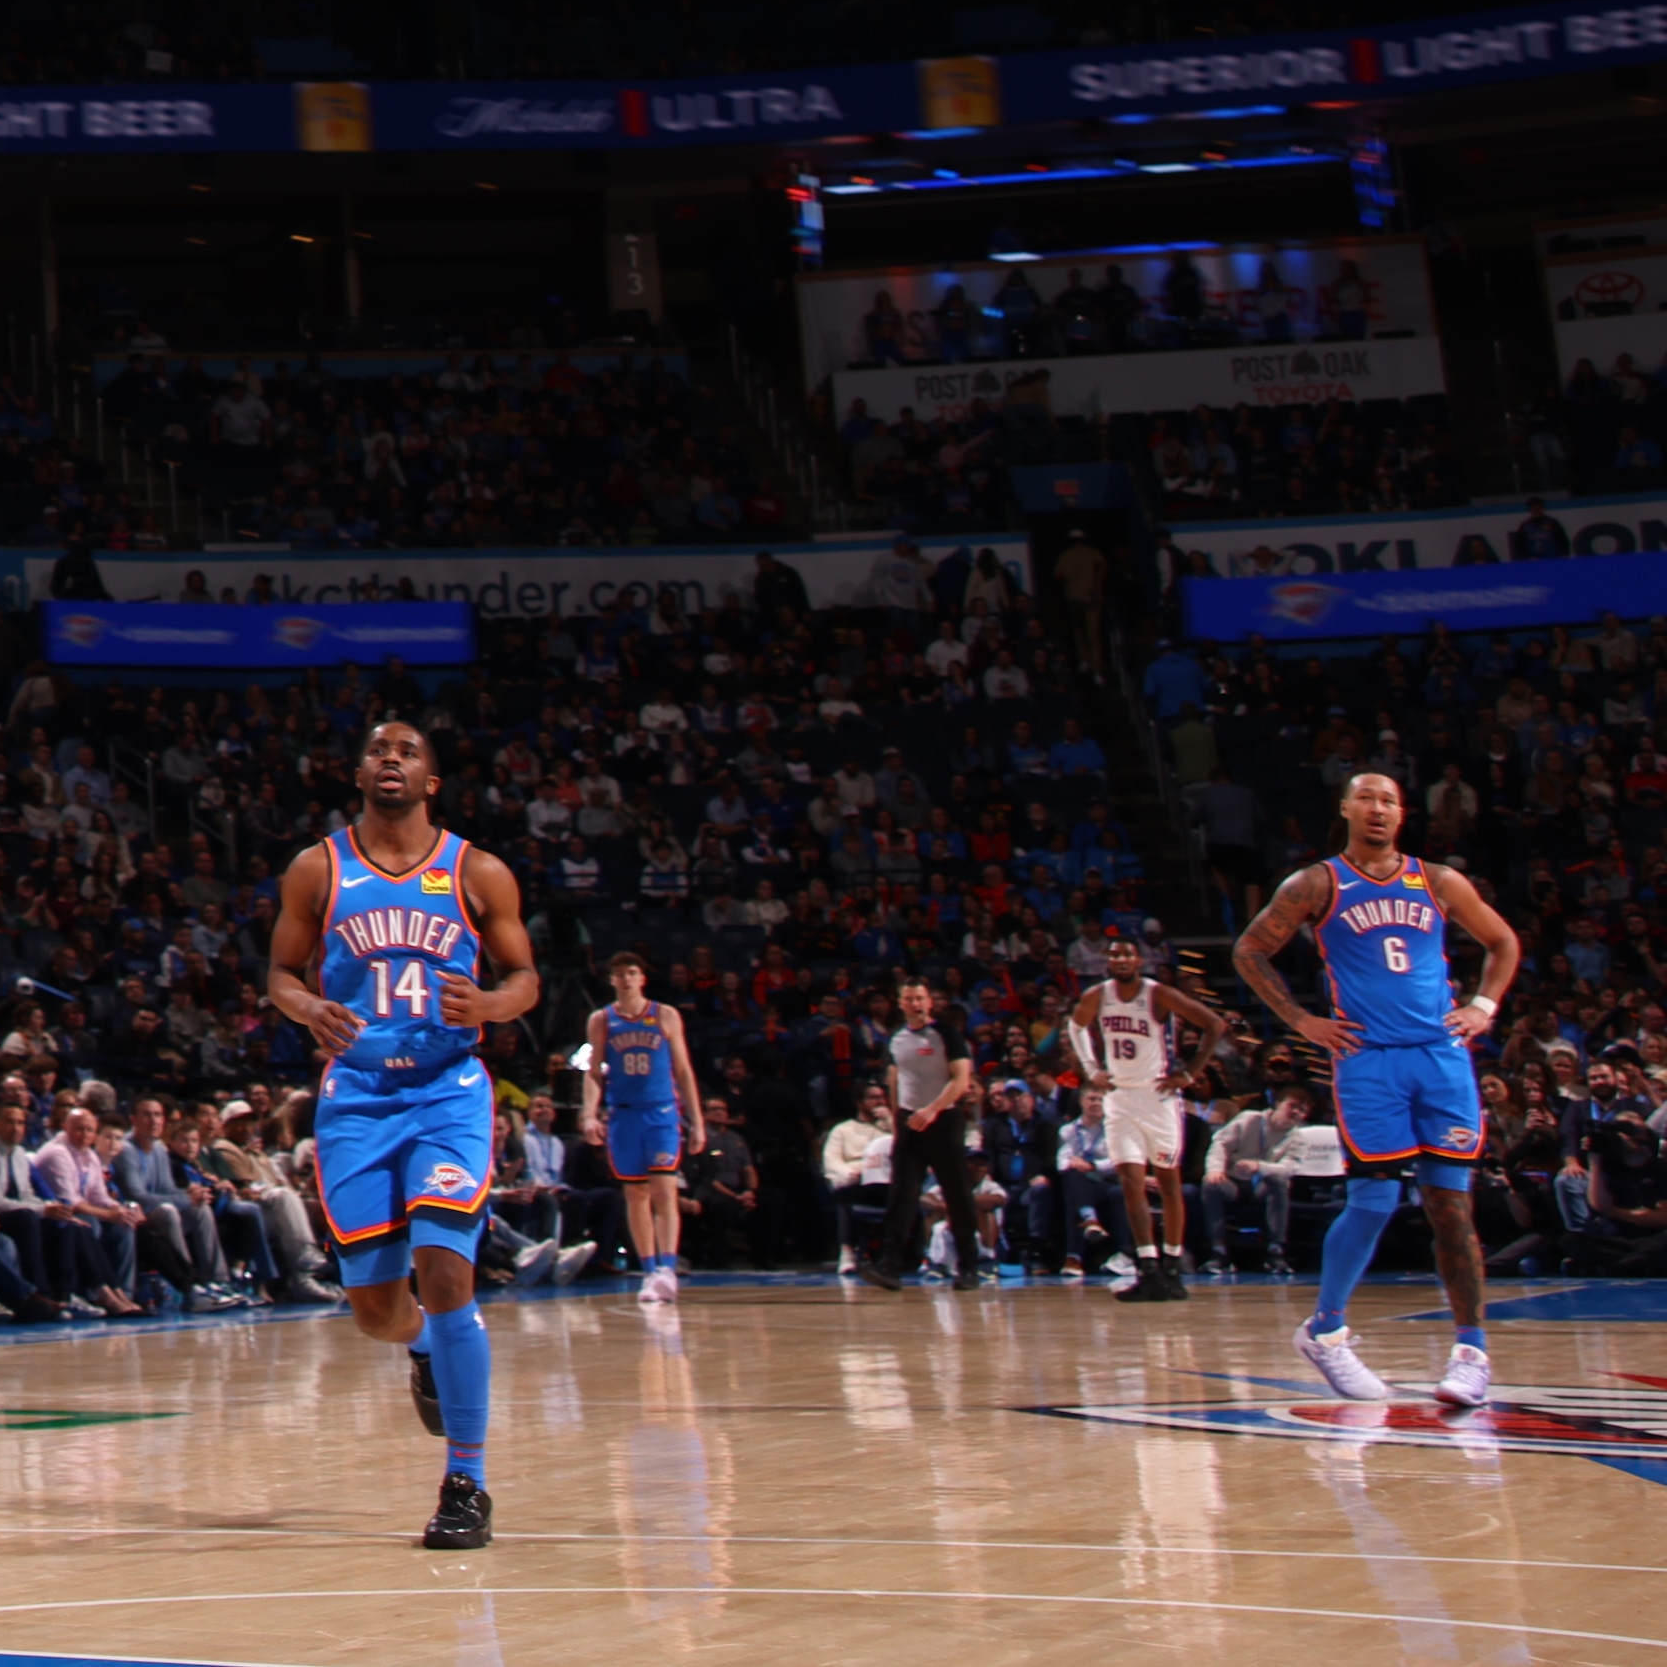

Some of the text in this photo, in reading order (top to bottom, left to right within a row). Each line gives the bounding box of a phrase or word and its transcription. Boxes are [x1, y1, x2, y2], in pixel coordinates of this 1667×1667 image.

[1069, 46, 1349, 102] SUPERIOR
[1380, 19, 1558, 79] LIGHT
[80, 100, 214, 138] BEER
[650, 83, 847, 132] ULTRA
[1232, 348, 1373, 382] POST OAK
[915, 373, 969, 402] POST
[1252, 381, 1353, 406] TOYOTA
[334, 906, 465, 960] THUNDER
[1339, 898, 1435, 934] THUNDER
[1381, 936, 1409, 973] 6
[369, 958, 431, 1020] 14
[609, 1030, 663, 1053] THUNDER
[1101, 1016, 1151, 1038] PHILA
[623, 1052, 652, 1076] 88
[1112, 1038, 1137, 1060] 19
